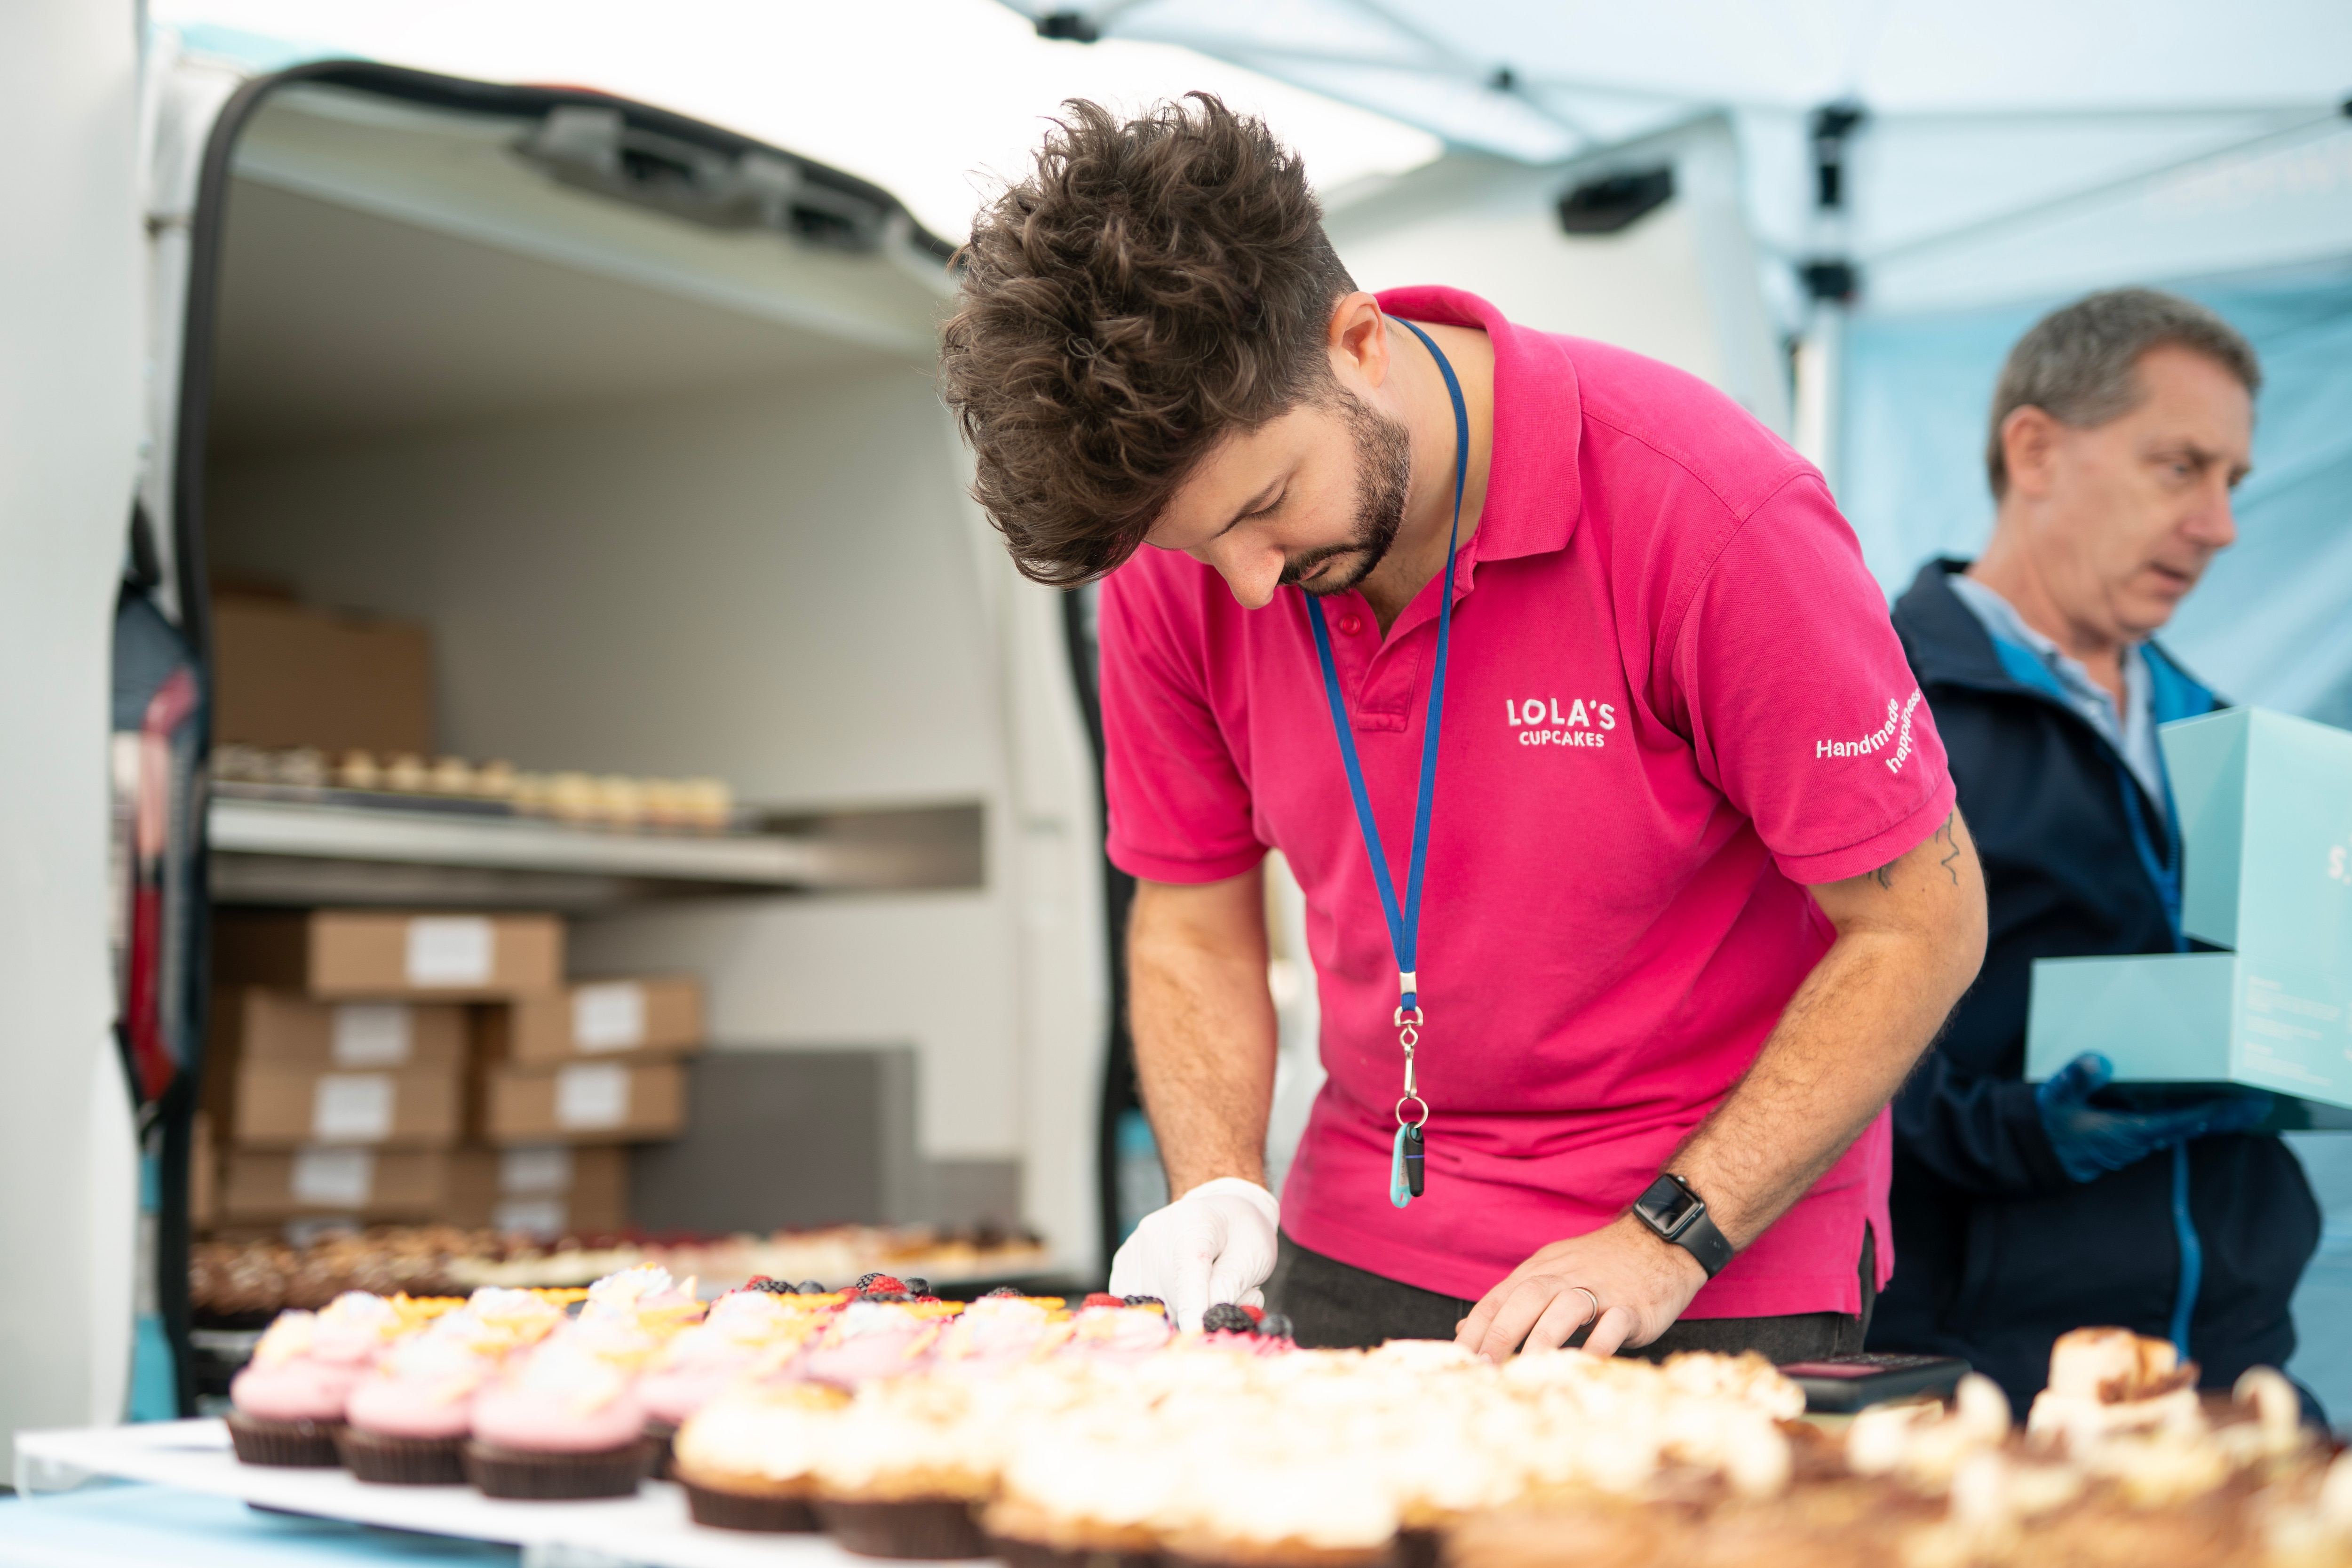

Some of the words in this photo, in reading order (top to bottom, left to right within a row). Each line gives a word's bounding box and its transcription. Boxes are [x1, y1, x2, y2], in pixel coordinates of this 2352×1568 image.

[1507, 698, 1615, 730] LOLA'S
[1817, 698, 1899, 758] Handmade
[1886, 688, 1921, 773] happiness
[1519, 730, 1605, 747] CUPCAKES
